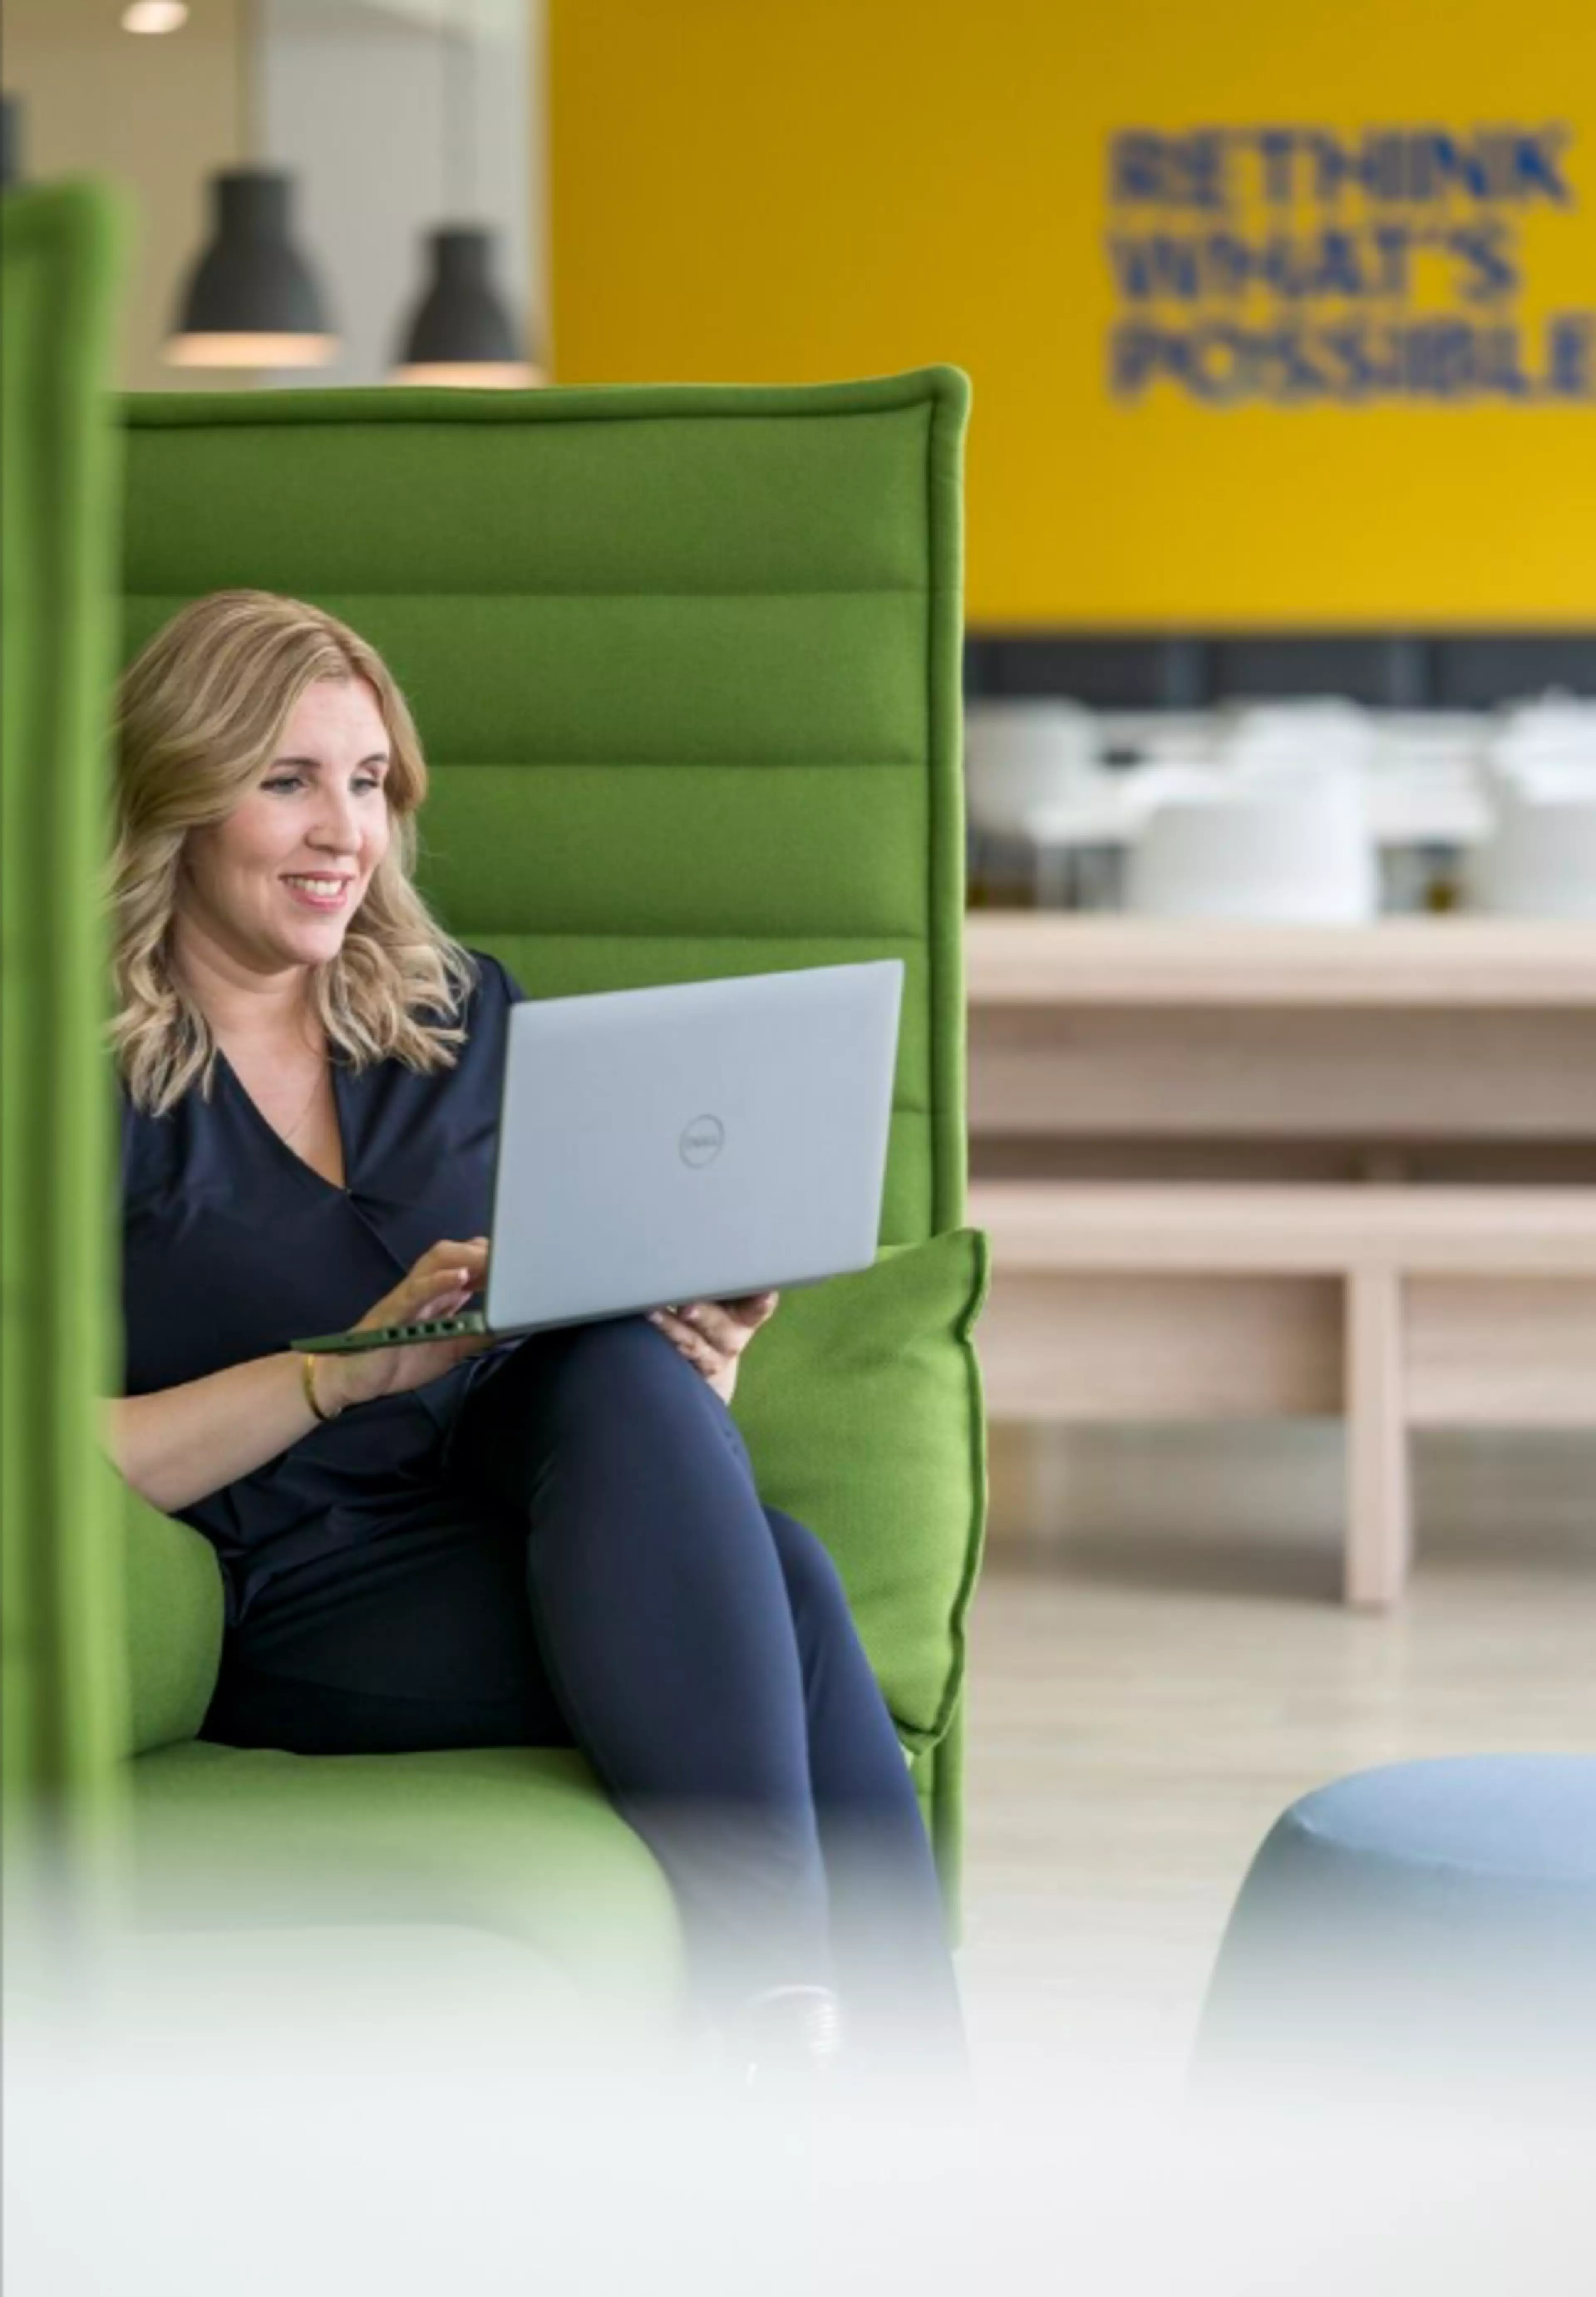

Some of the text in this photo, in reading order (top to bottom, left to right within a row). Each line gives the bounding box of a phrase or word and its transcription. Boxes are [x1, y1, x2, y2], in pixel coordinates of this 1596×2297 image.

[1110, 124, 1571, 208] RETHINK
[1107, 227, 1518, 303] WHAT'S
[1109, 317, 1596, 403] POSSIBLE
